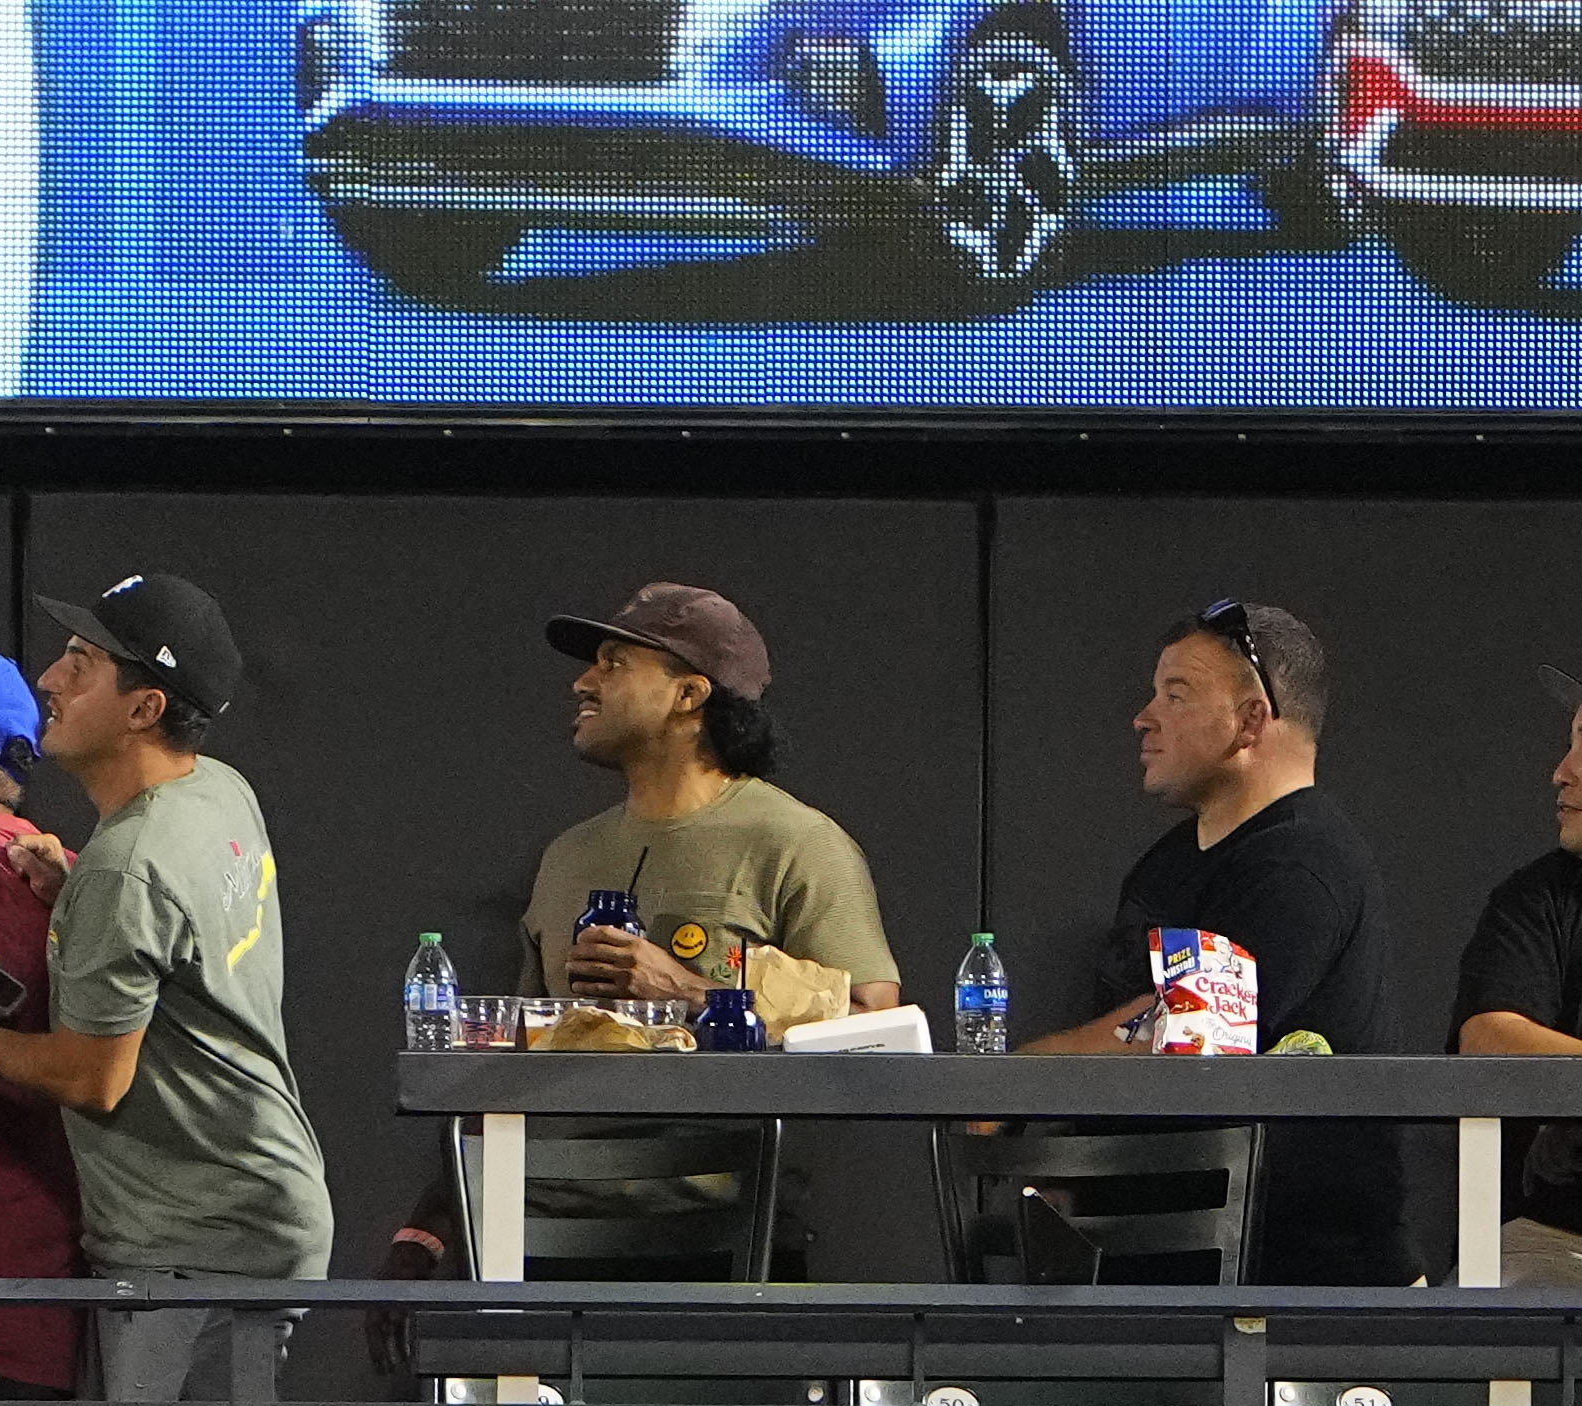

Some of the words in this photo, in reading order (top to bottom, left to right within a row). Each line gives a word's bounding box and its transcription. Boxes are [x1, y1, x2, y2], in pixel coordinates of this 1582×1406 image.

[1167, 947, 1192, 965] PRIZE
[1195, 977, 1257, 1006] Cracker
[1209, 996, 1247, 1020] Jack
